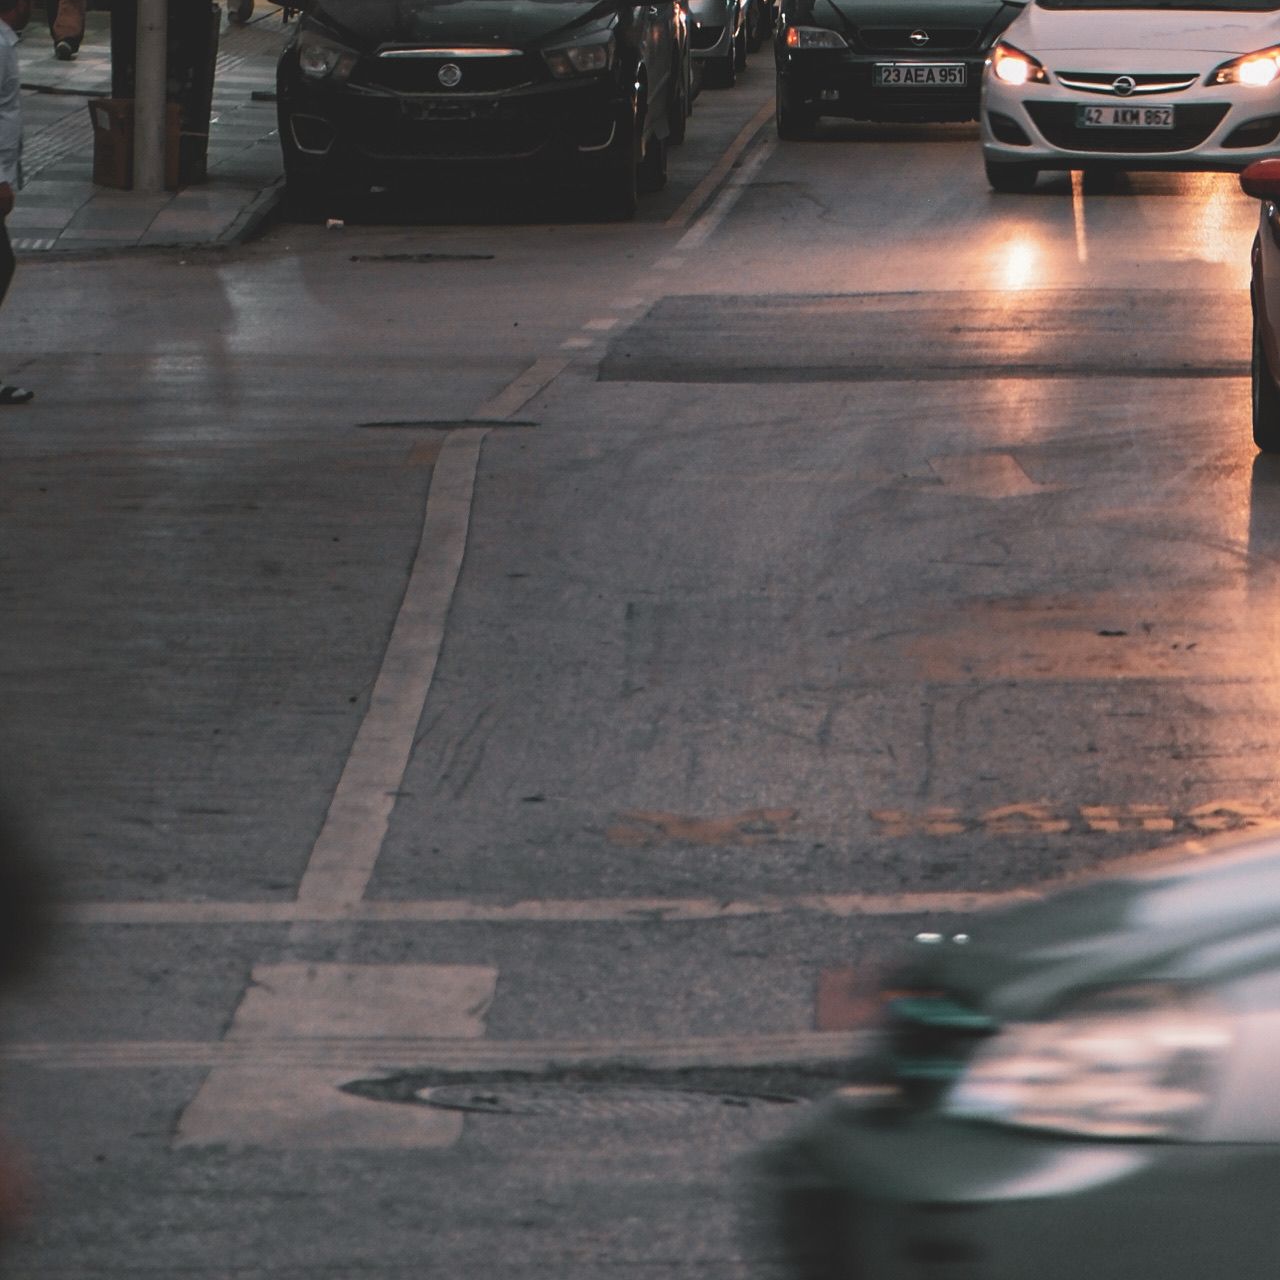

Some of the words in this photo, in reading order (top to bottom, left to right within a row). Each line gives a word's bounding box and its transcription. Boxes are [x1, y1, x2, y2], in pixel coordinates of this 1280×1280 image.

[881, 67, 901, 83] 23
[904, 68, 936, 83] AEA
[939, 68, 963, 83] 951
[1086, 108, 1104, 124] 42
[1112, 109, 1140, 124] AKM
[1144, 109, 1171, 125] 862
